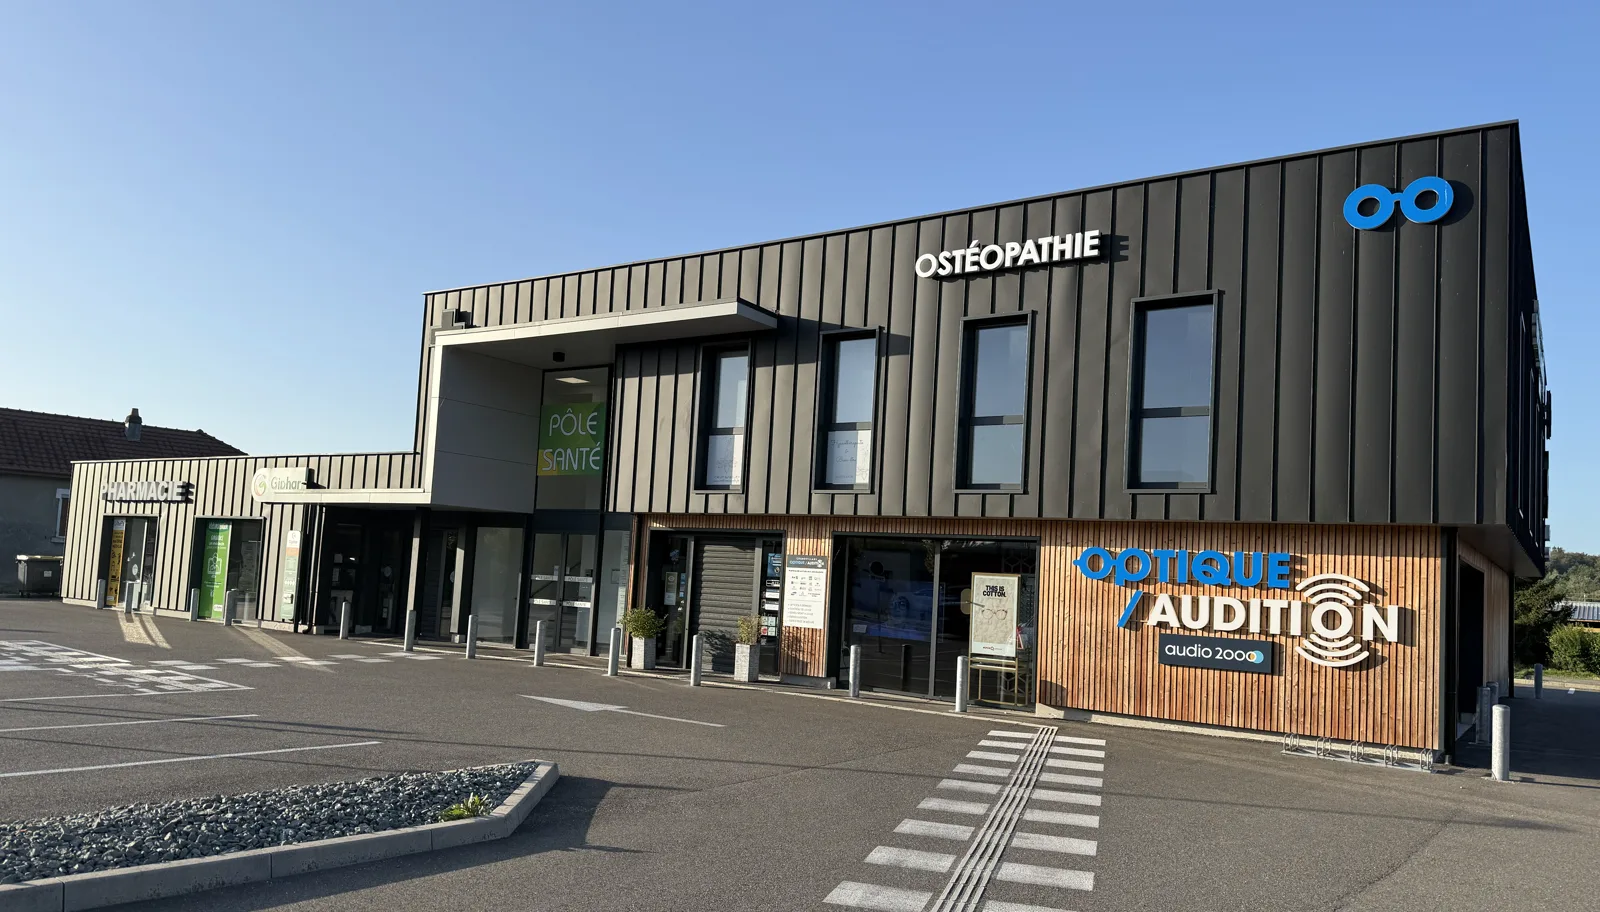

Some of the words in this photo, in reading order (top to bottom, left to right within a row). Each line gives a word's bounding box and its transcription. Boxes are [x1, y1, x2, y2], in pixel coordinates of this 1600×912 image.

[915, 229, 1100, 278] OSTÉOPATHIE
[549, 408, 598, 436] PÔLE
[542, 441, 601, 471] SANTÉ
[100, 480, 183, 501] PHARMACIE
[1164, 643, 1213, 659] audio
[1215, 646, 1258, 664] 2000
